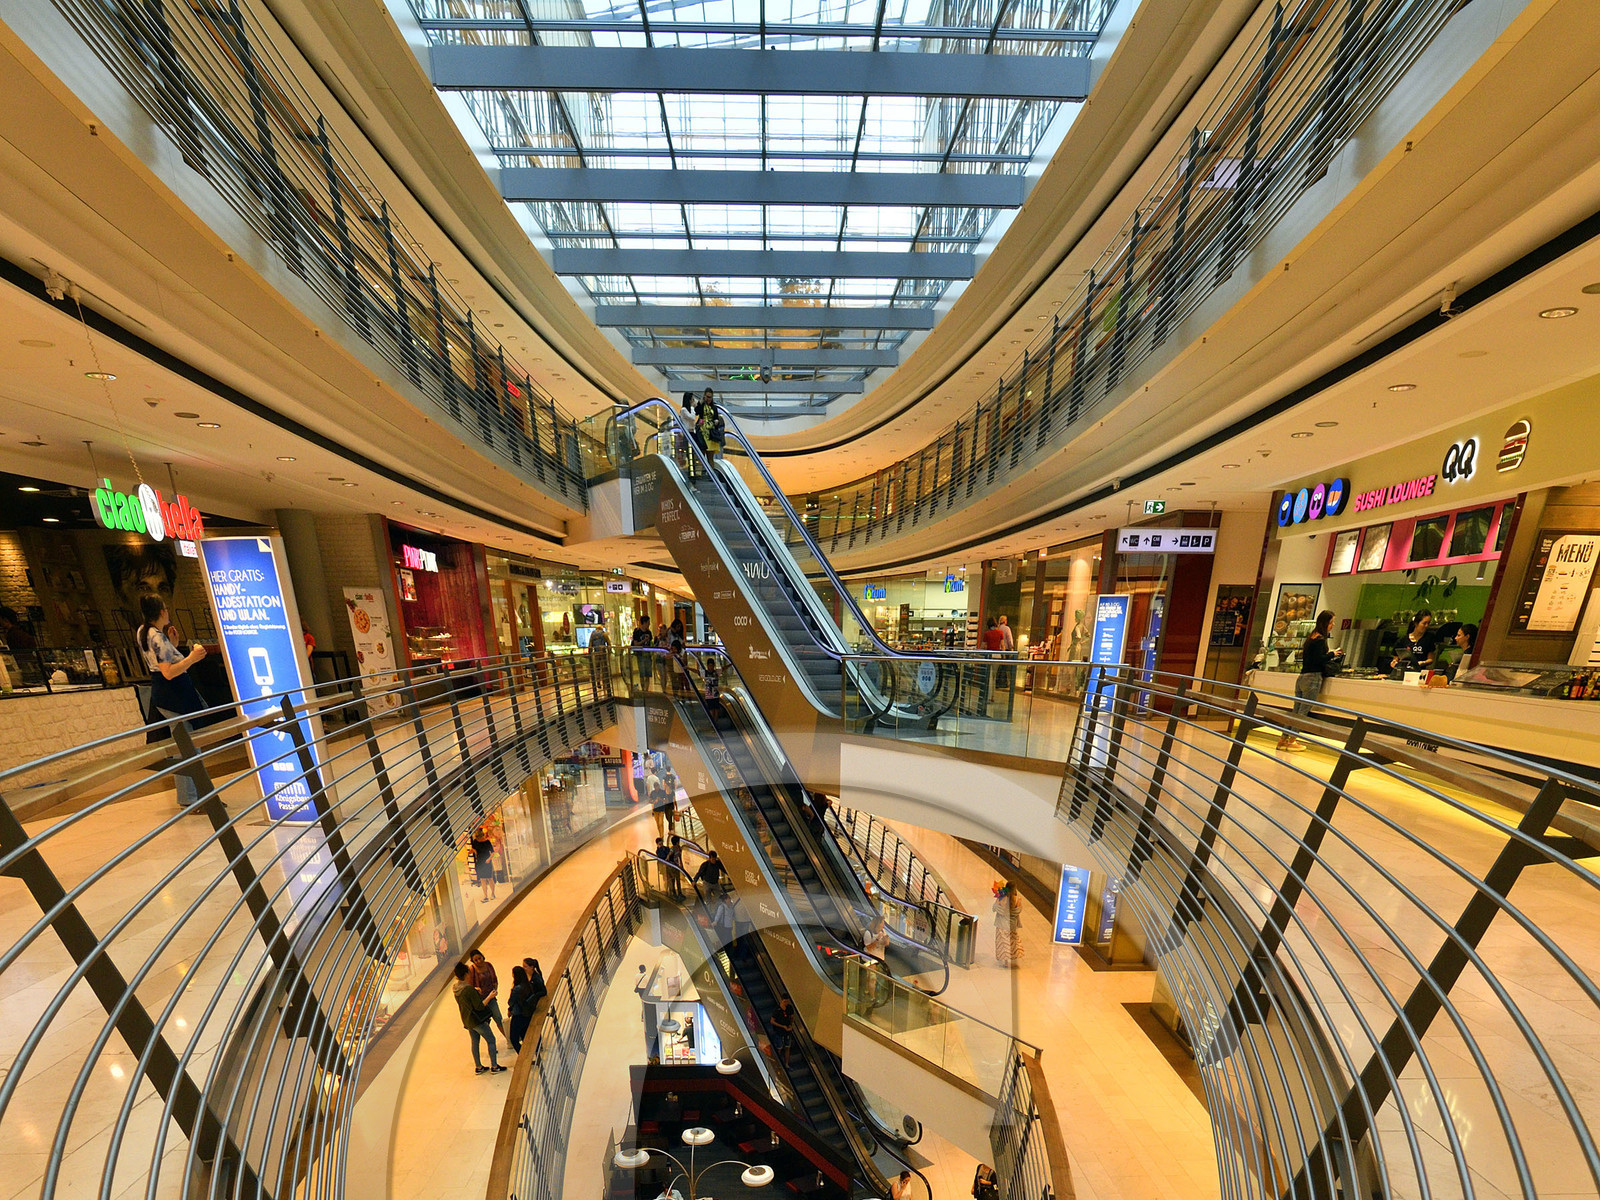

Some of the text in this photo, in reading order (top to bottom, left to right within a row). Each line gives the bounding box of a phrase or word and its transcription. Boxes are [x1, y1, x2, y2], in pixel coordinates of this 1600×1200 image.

[1442, 438, 1476, 482] QQ
[1353, 474, 1438, 513] SUSHI LOUNGE
[96, 478, 204, 540] ciao bella
[1204, 537, 1210, 545] P
[1556, 541, 1594, 562] MENÜ
[210, 569, 264, 582] HIER GRATIS:
[213, 583, 246, 595] HANDY-
[216, 595, 281, 608] LADESTATION
[219, 608, 270, 620] UND WLAN.
[734, 616, 747, 626] COCO
